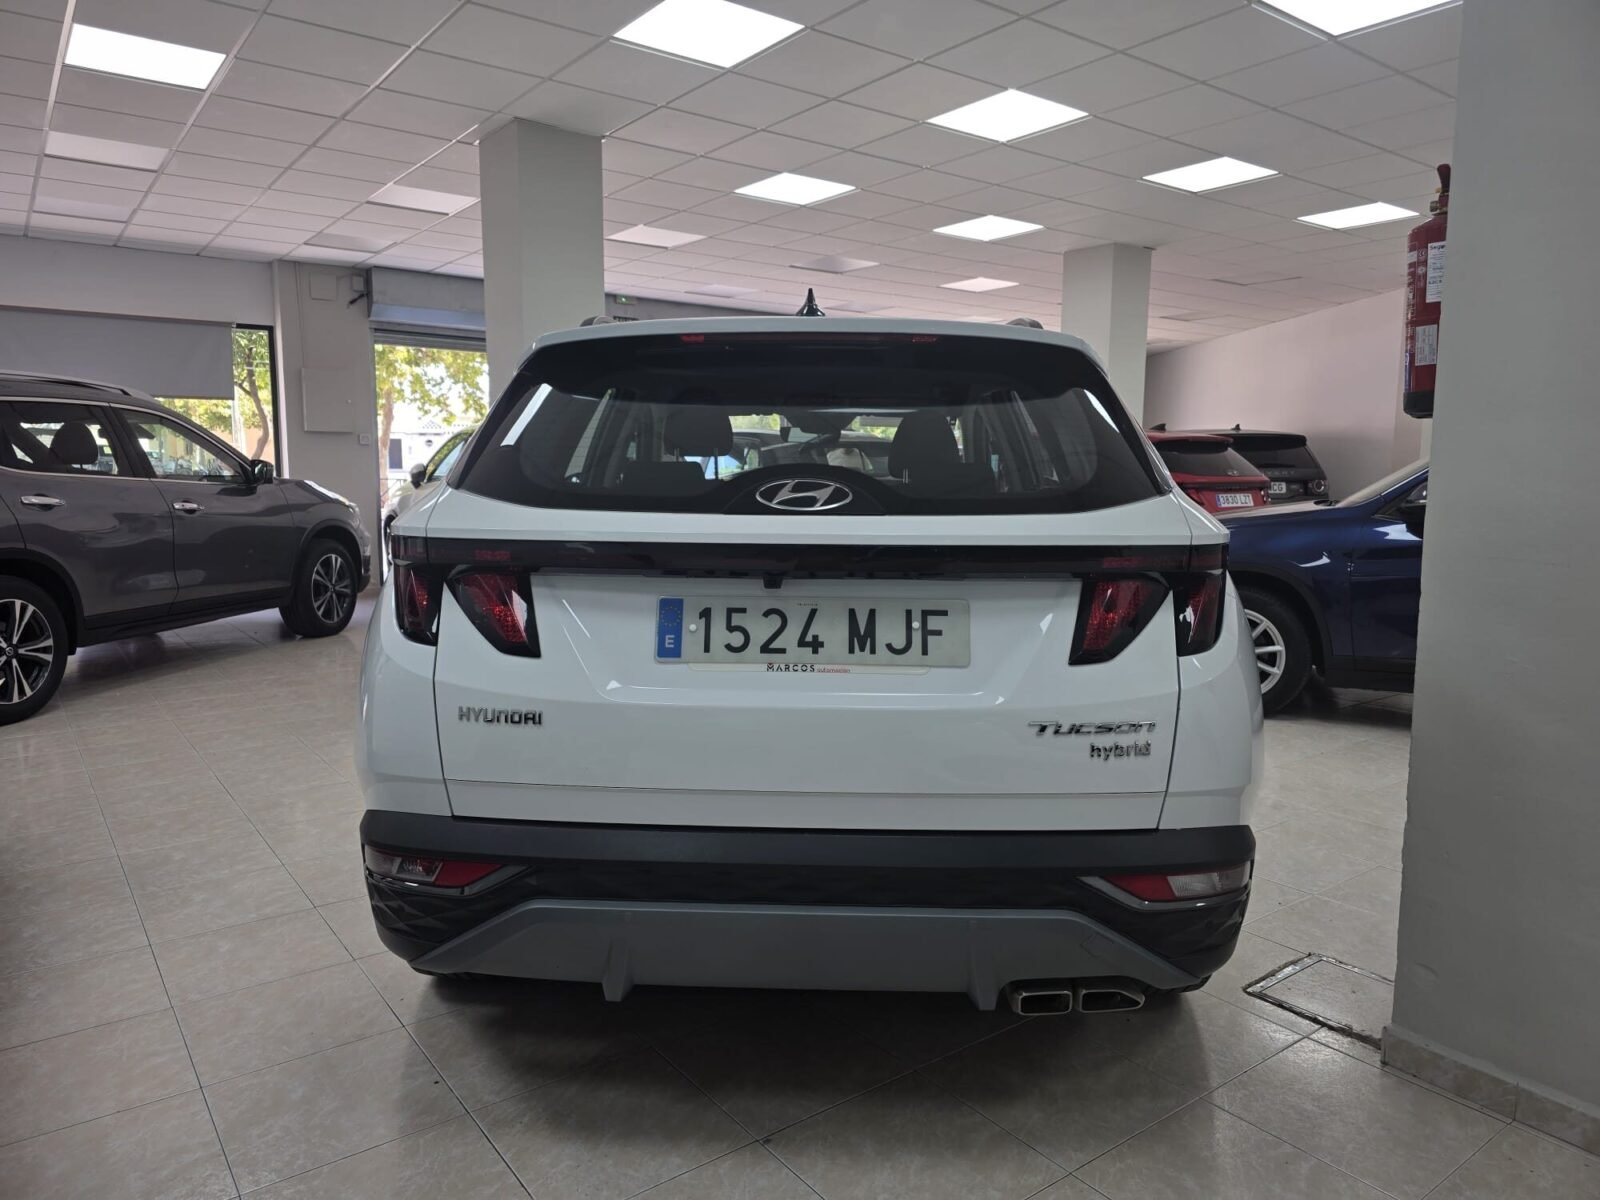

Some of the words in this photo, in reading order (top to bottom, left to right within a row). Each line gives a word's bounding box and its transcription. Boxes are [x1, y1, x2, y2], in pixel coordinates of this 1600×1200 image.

[698, 607, 825, 655] 1524
[848, 608, 949, 656] MJF
[665, 635, 675, 648] E
[766, 663, 815, 673] MARCOS
[1089, 740, 1152, 762] hybrid
